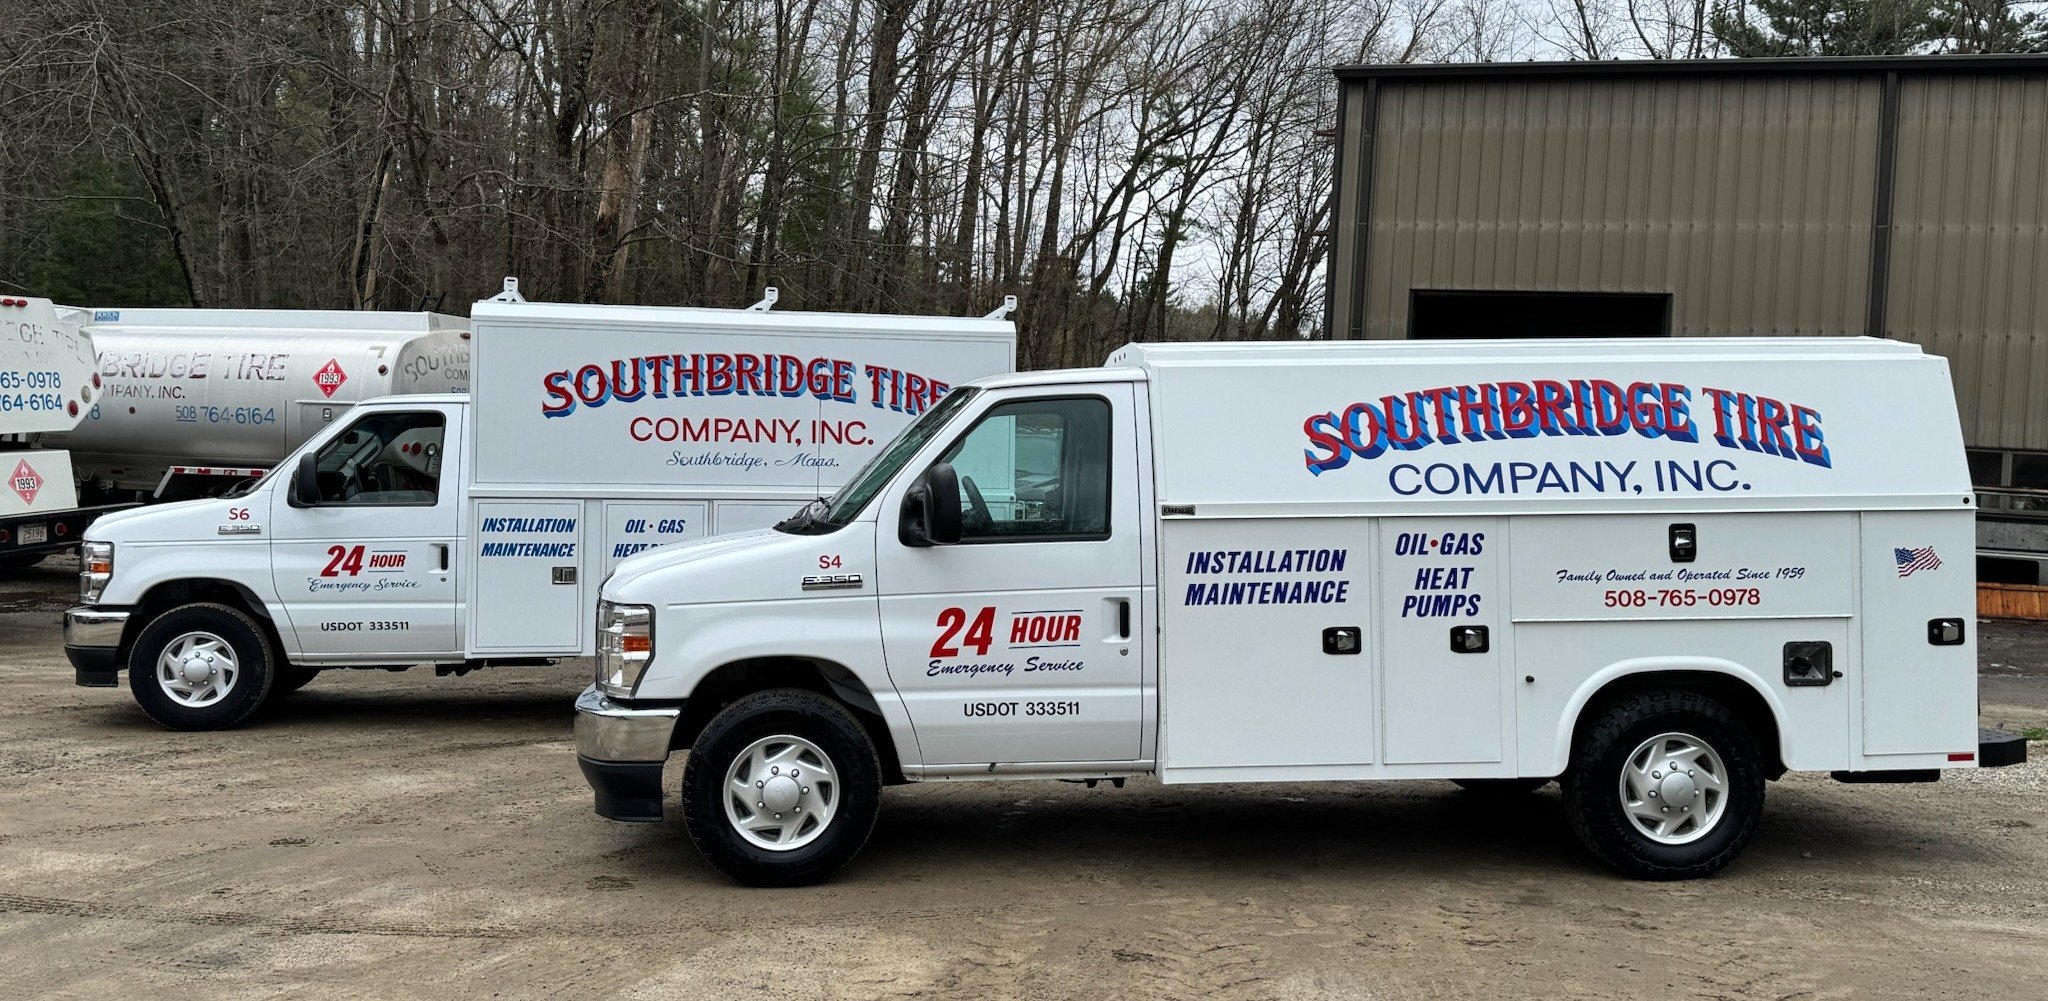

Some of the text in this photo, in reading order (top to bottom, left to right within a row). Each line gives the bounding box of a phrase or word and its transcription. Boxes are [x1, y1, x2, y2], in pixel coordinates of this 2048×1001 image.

[98, 350, 290, 381] BRIDGE TIRE
[445, 368, 470, 381] COM
[320, 372, 340, 384] 1993
[542, 353, 857, 419] SOUTHBRIDGE
[158, 385, 185, 399] INC.
[0, 393, 63, 411] 64-6164
[175, 405, 276, 425] 508 764-6164
[630, 416, 875, 446] COMPANY, INC.
[1302, 379, 1832, 477] SOUTHBRIDGE TIRE
[17, 477, 36, 490] 1993
[1388, 459, 1752, 496] COMPANY, INC.
[25, 492, 31, 500] 3
[228, 507, 250, 521] S6
[481, 517, 577, 533] INSTALLATION
[624, 519, 686, 534] OIL GAS
[480, 542, 576, 558] MAINTENANCE
[320, 545, 407, 578] 24 HOUR
[818, 554, 843, 570] S4
[1185, 549, 1348, 574] INSTALLATION
[1414, 567, 1475, 590] HEAT
[1556, 567, 1806, 584] Family Owned and Operated Since 1959
[307, 577, 421, 593] Emergency Service
[1184, 580, 1350, 606] MAINTENANCE
[1401, 594, 1482, 618] PUMPS
[1604, 587, 1761, 608] 508-765-0978
[320, 621, 410, 631] USDOT 333511
[929, 606, 1082, 659] 24 HOUR
[926, 656, 1085, 679] Emergency Service
[963, 701, 1080, 717] USDOT 333511
